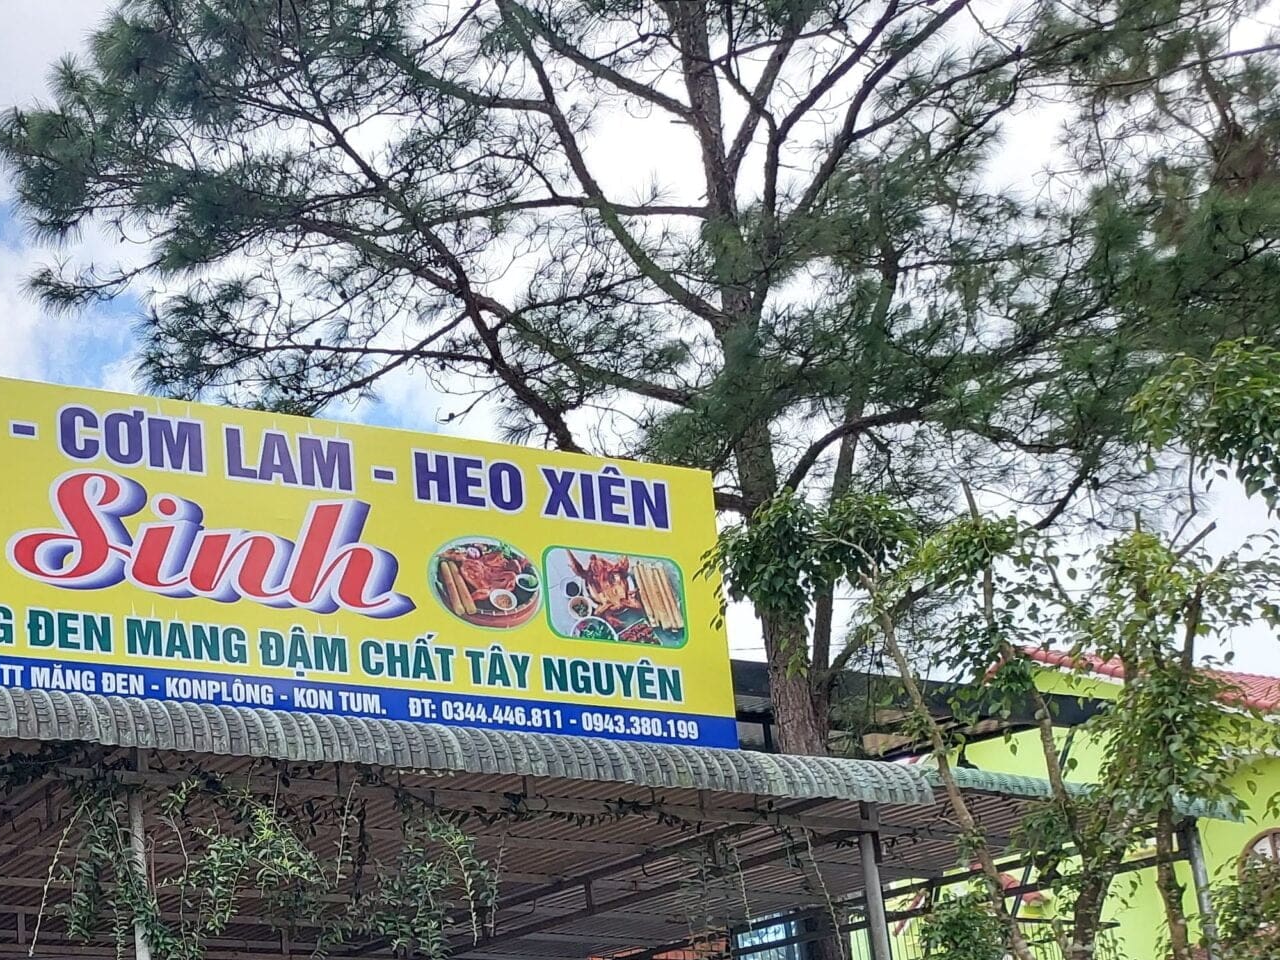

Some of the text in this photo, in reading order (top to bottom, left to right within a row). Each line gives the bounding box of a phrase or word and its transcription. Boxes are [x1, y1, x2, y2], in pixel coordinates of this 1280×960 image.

[11, 424, 37, 436] -
[60, 406, 203, 472] CƠM
[227, 428, 352, 491] LAM
[374, 469, 394, 481] -
[414, 451, 522, 507] HEO
[543, 467, 669, 529] XIÊN
[7, 469, 416, 619] Sinh
[0, 664, 24, 687] TT
[31, 664, 96, 692] MĂNG
[101, 671, 144, 696] ĐEN
[166, 677, 274, 705] KONPLÔNG
[294, 687, 333, 711] KON
[338, 691, 387, 715] TUM.
[408, 697, 437, 719] ĐT:
[442, 703, 562, 728] 0344.446.811
[582, 712, 699, 739] 0943.380.199
[27, 607, 111, 653] ĐEN
[127, 618, 247, 666] MANG
[260, 628, 348, 677] ĐẬM
[361, 632, 455, 686] CHẤT
[467, 646, 530, 689] TÂY
[544, 655, 683, 702] NGUYÊN
